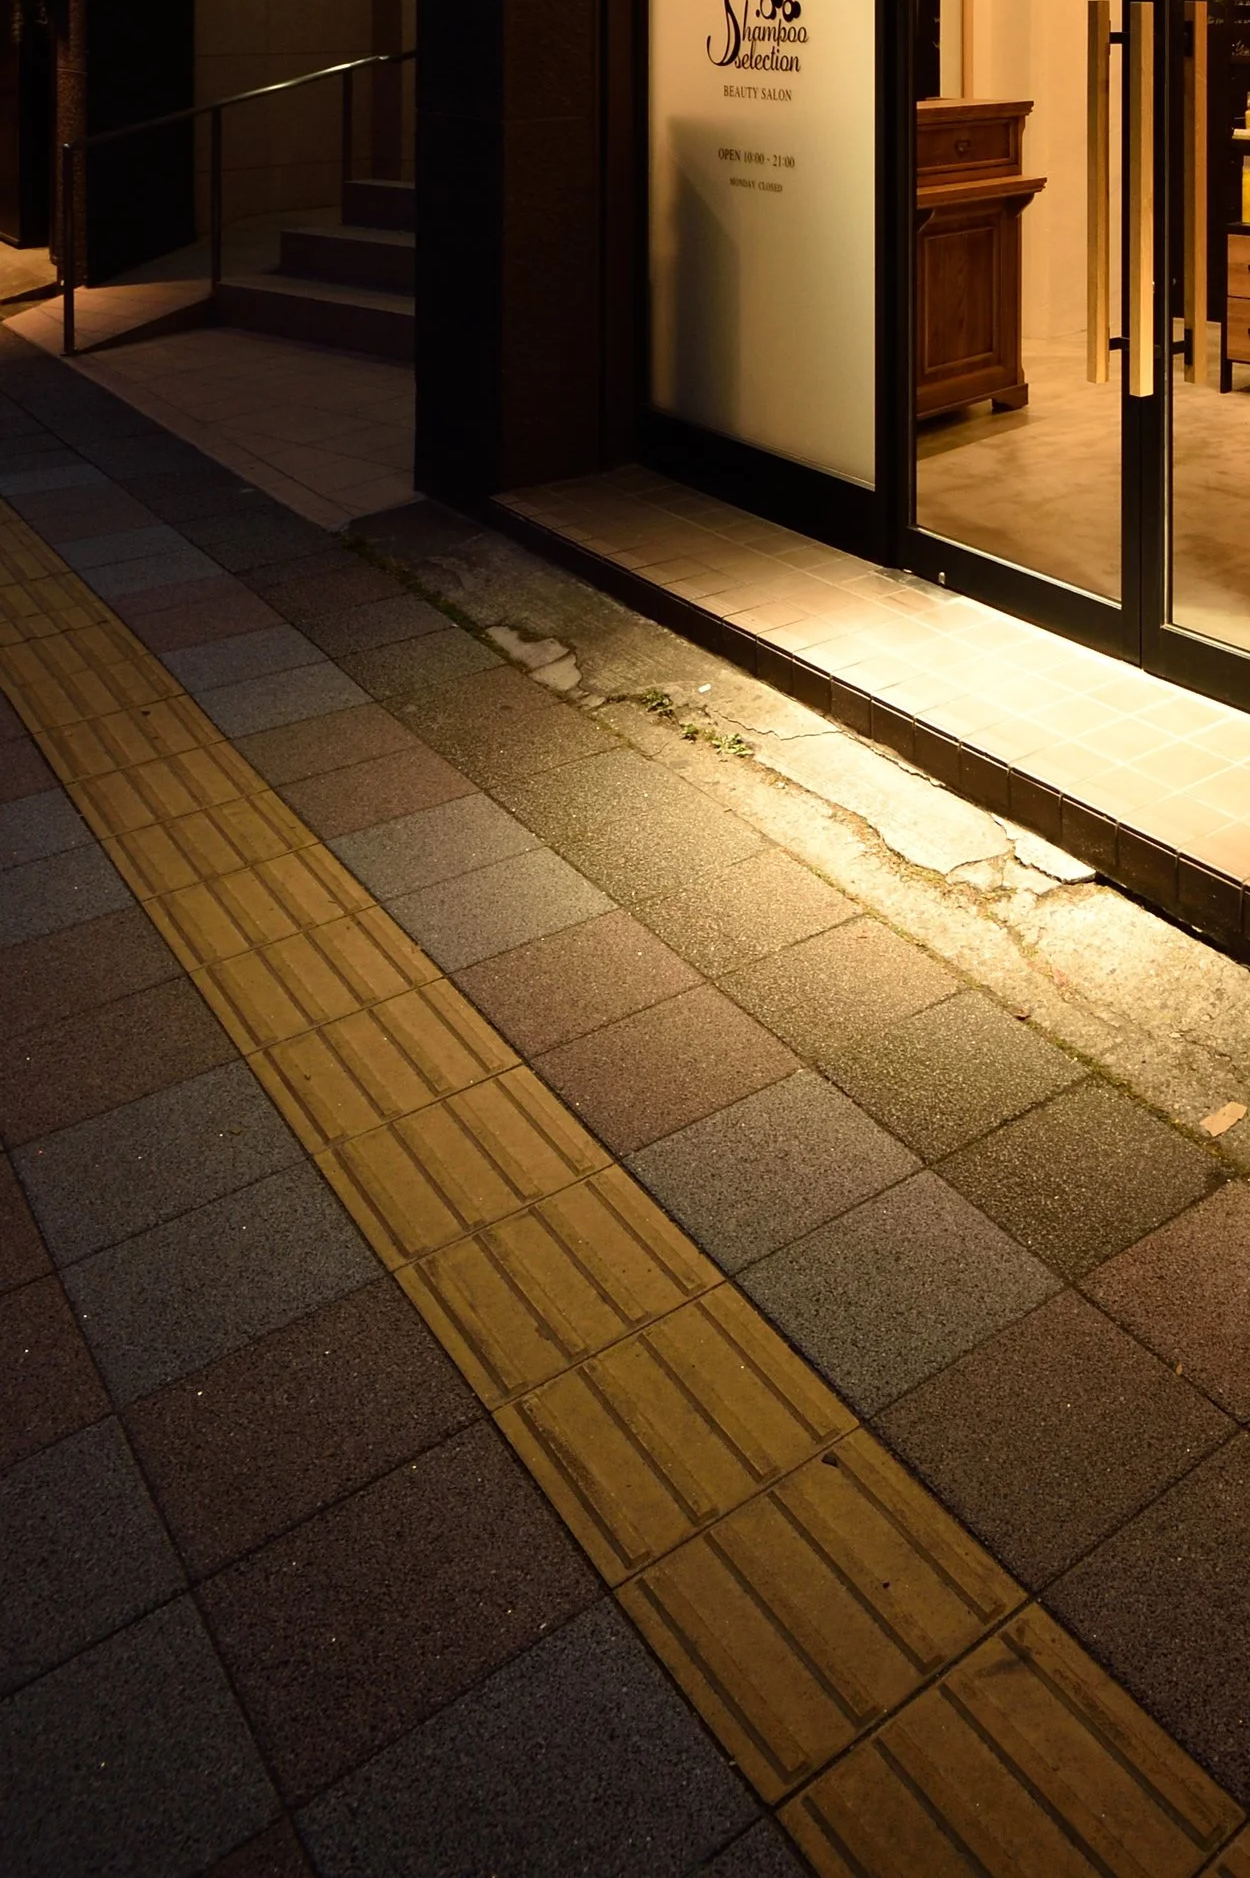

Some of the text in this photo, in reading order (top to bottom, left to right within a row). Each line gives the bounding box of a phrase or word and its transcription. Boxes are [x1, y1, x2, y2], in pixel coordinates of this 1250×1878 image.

[723, 85, 792, 101] BEAUTY SALON
[718, 147, 741, 161] OPEN
[743, 150, 765, 165] 10:00
[772, 154, 795, 168] 21:00
